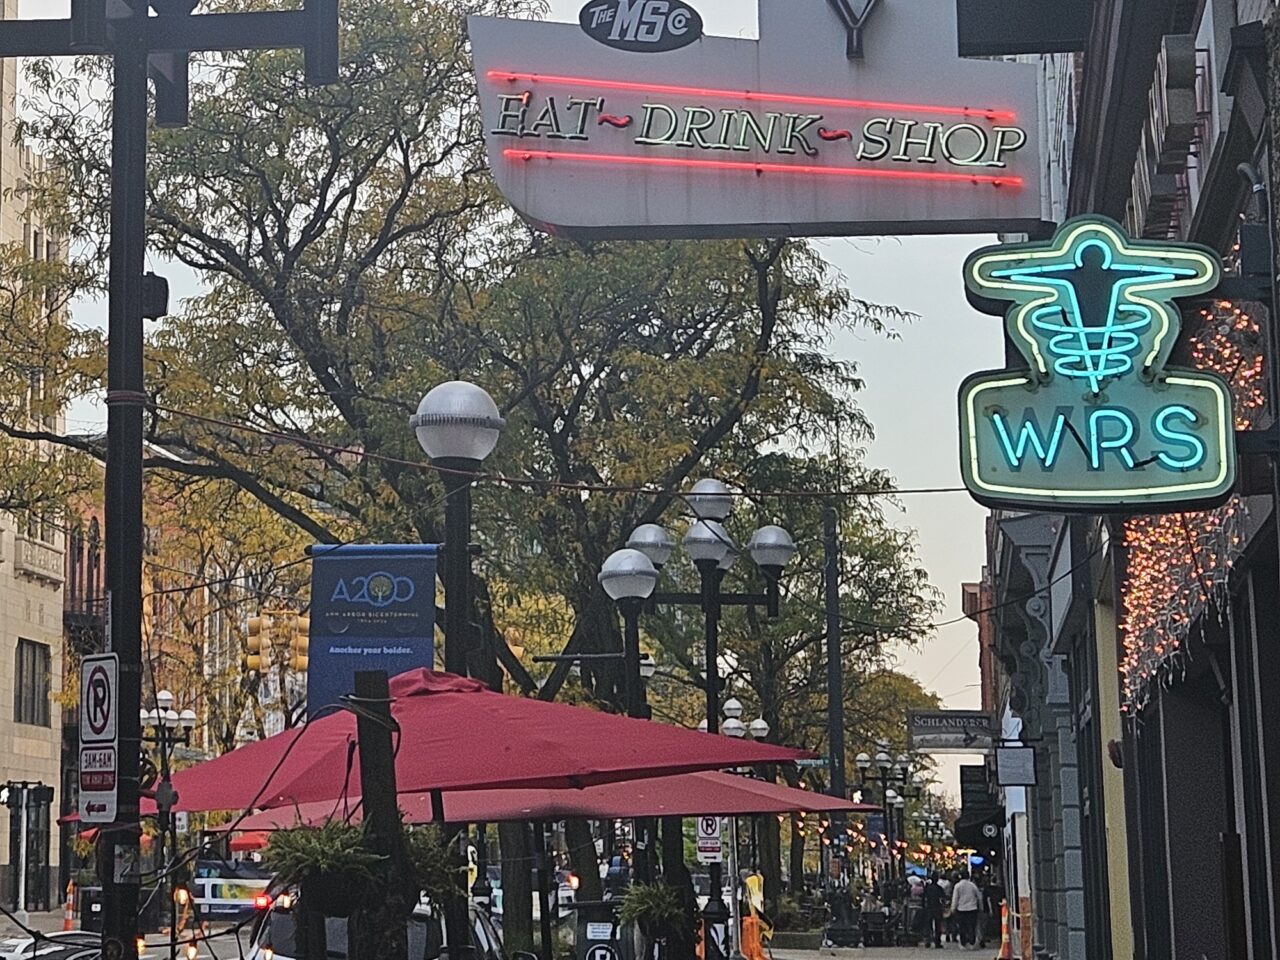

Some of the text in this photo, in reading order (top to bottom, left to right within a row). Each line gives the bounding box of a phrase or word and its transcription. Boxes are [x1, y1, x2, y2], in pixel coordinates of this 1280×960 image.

[589, 4, 616, 28] THE
[491, 91, 1027, 168] EAT DRINK SHOP
[988, 404, 1208, 473] WRS
[329, 646, 362, 654] Another
